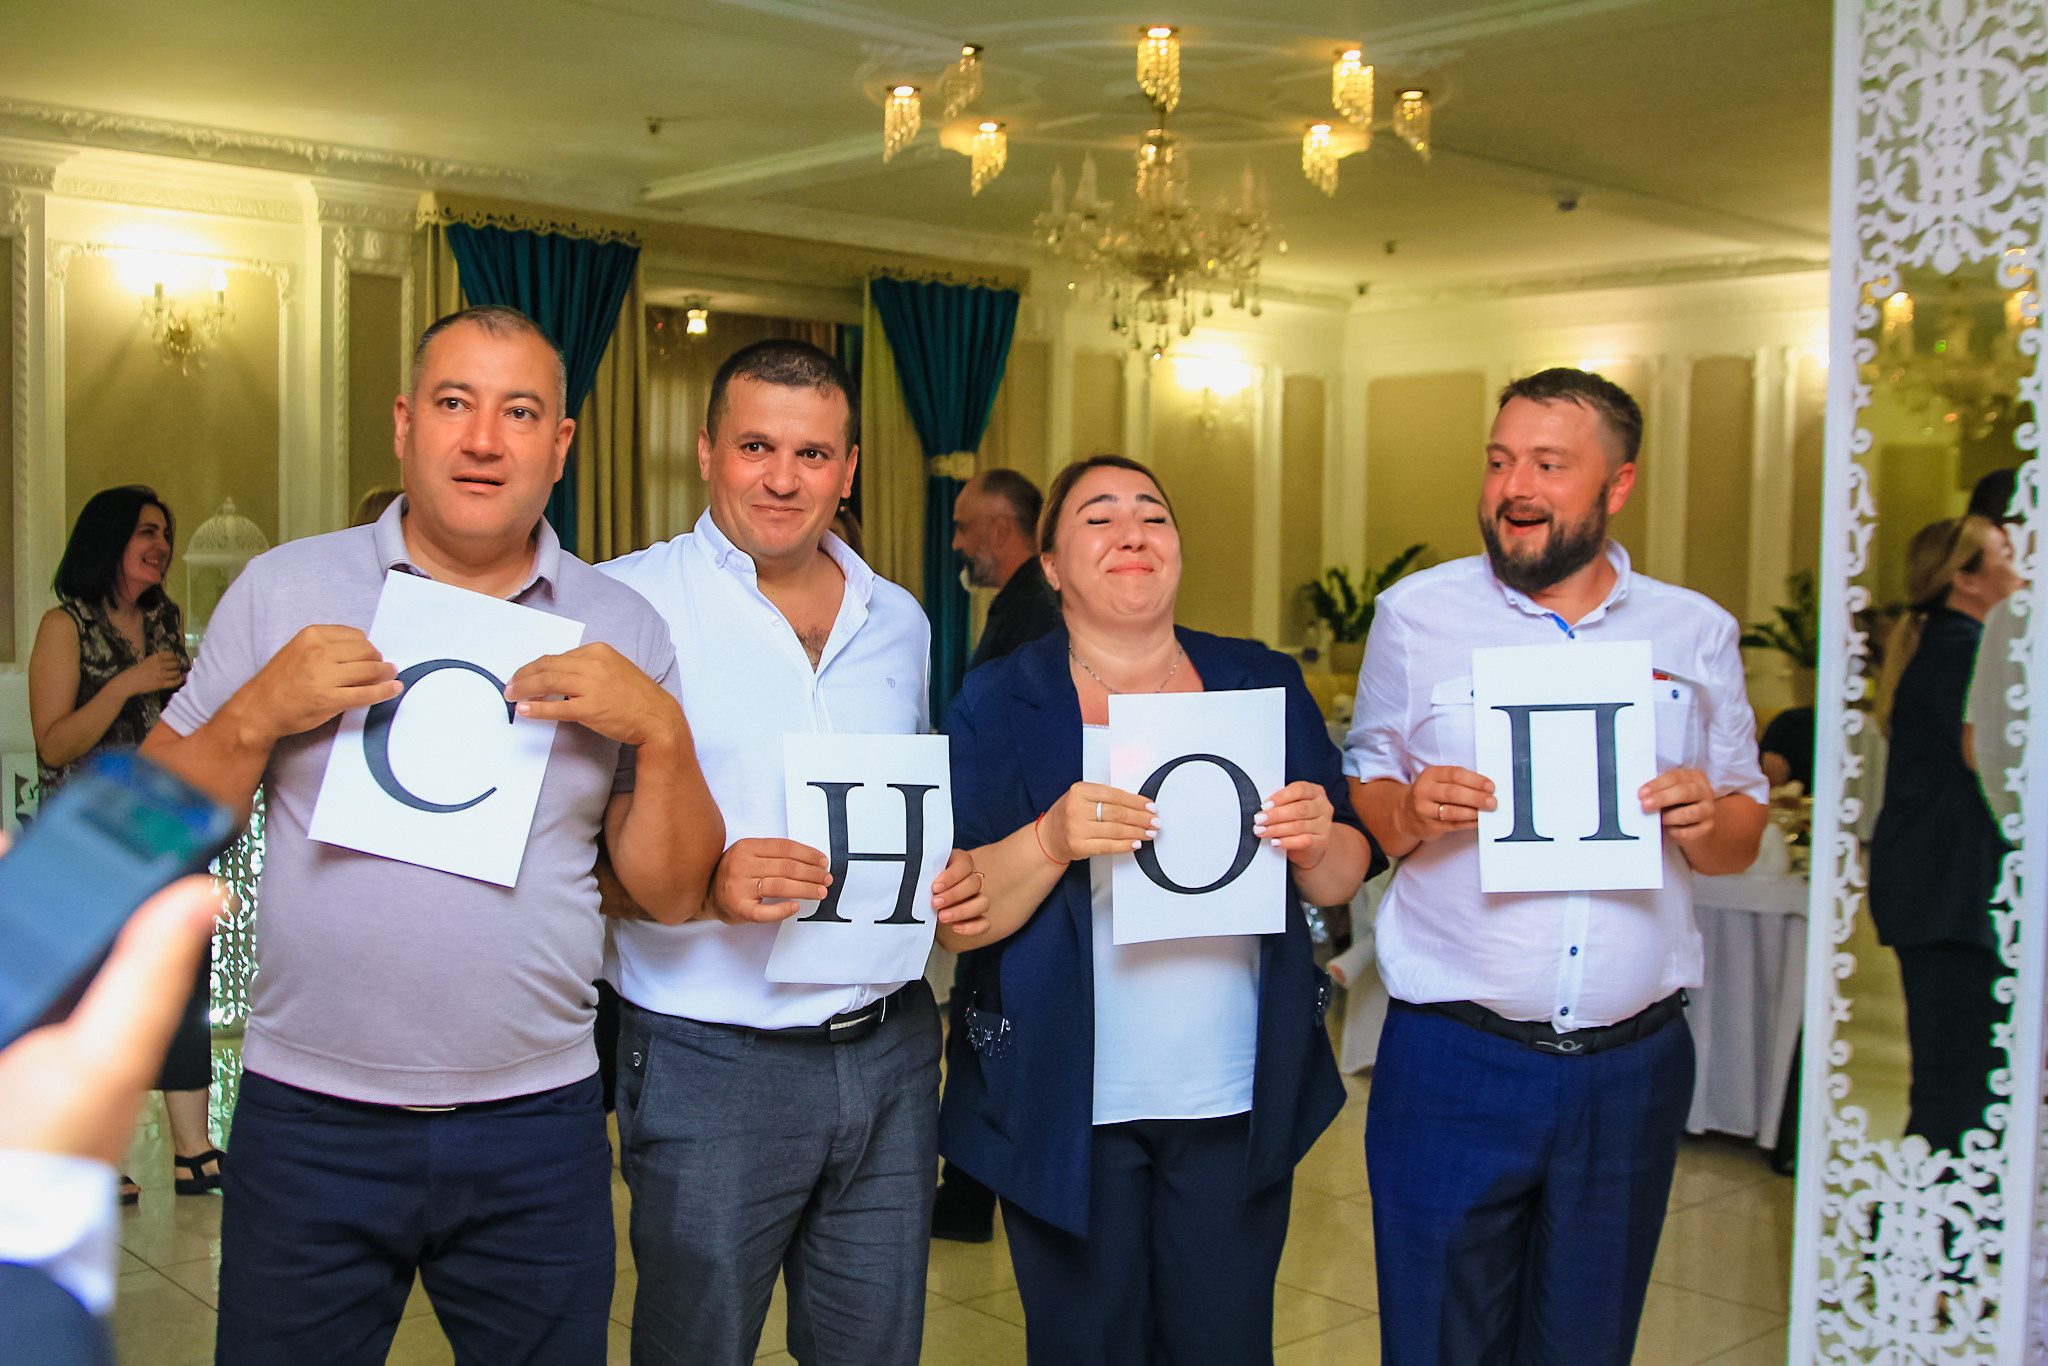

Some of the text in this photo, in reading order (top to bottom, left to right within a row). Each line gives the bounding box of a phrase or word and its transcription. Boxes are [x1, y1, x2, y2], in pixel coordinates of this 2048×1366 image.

[363, 658, 516, 813] С
[1490, 702, 1640, 842] П
[796, 781, 940, 925] Н
[1133, 753, 1263, 894] О
